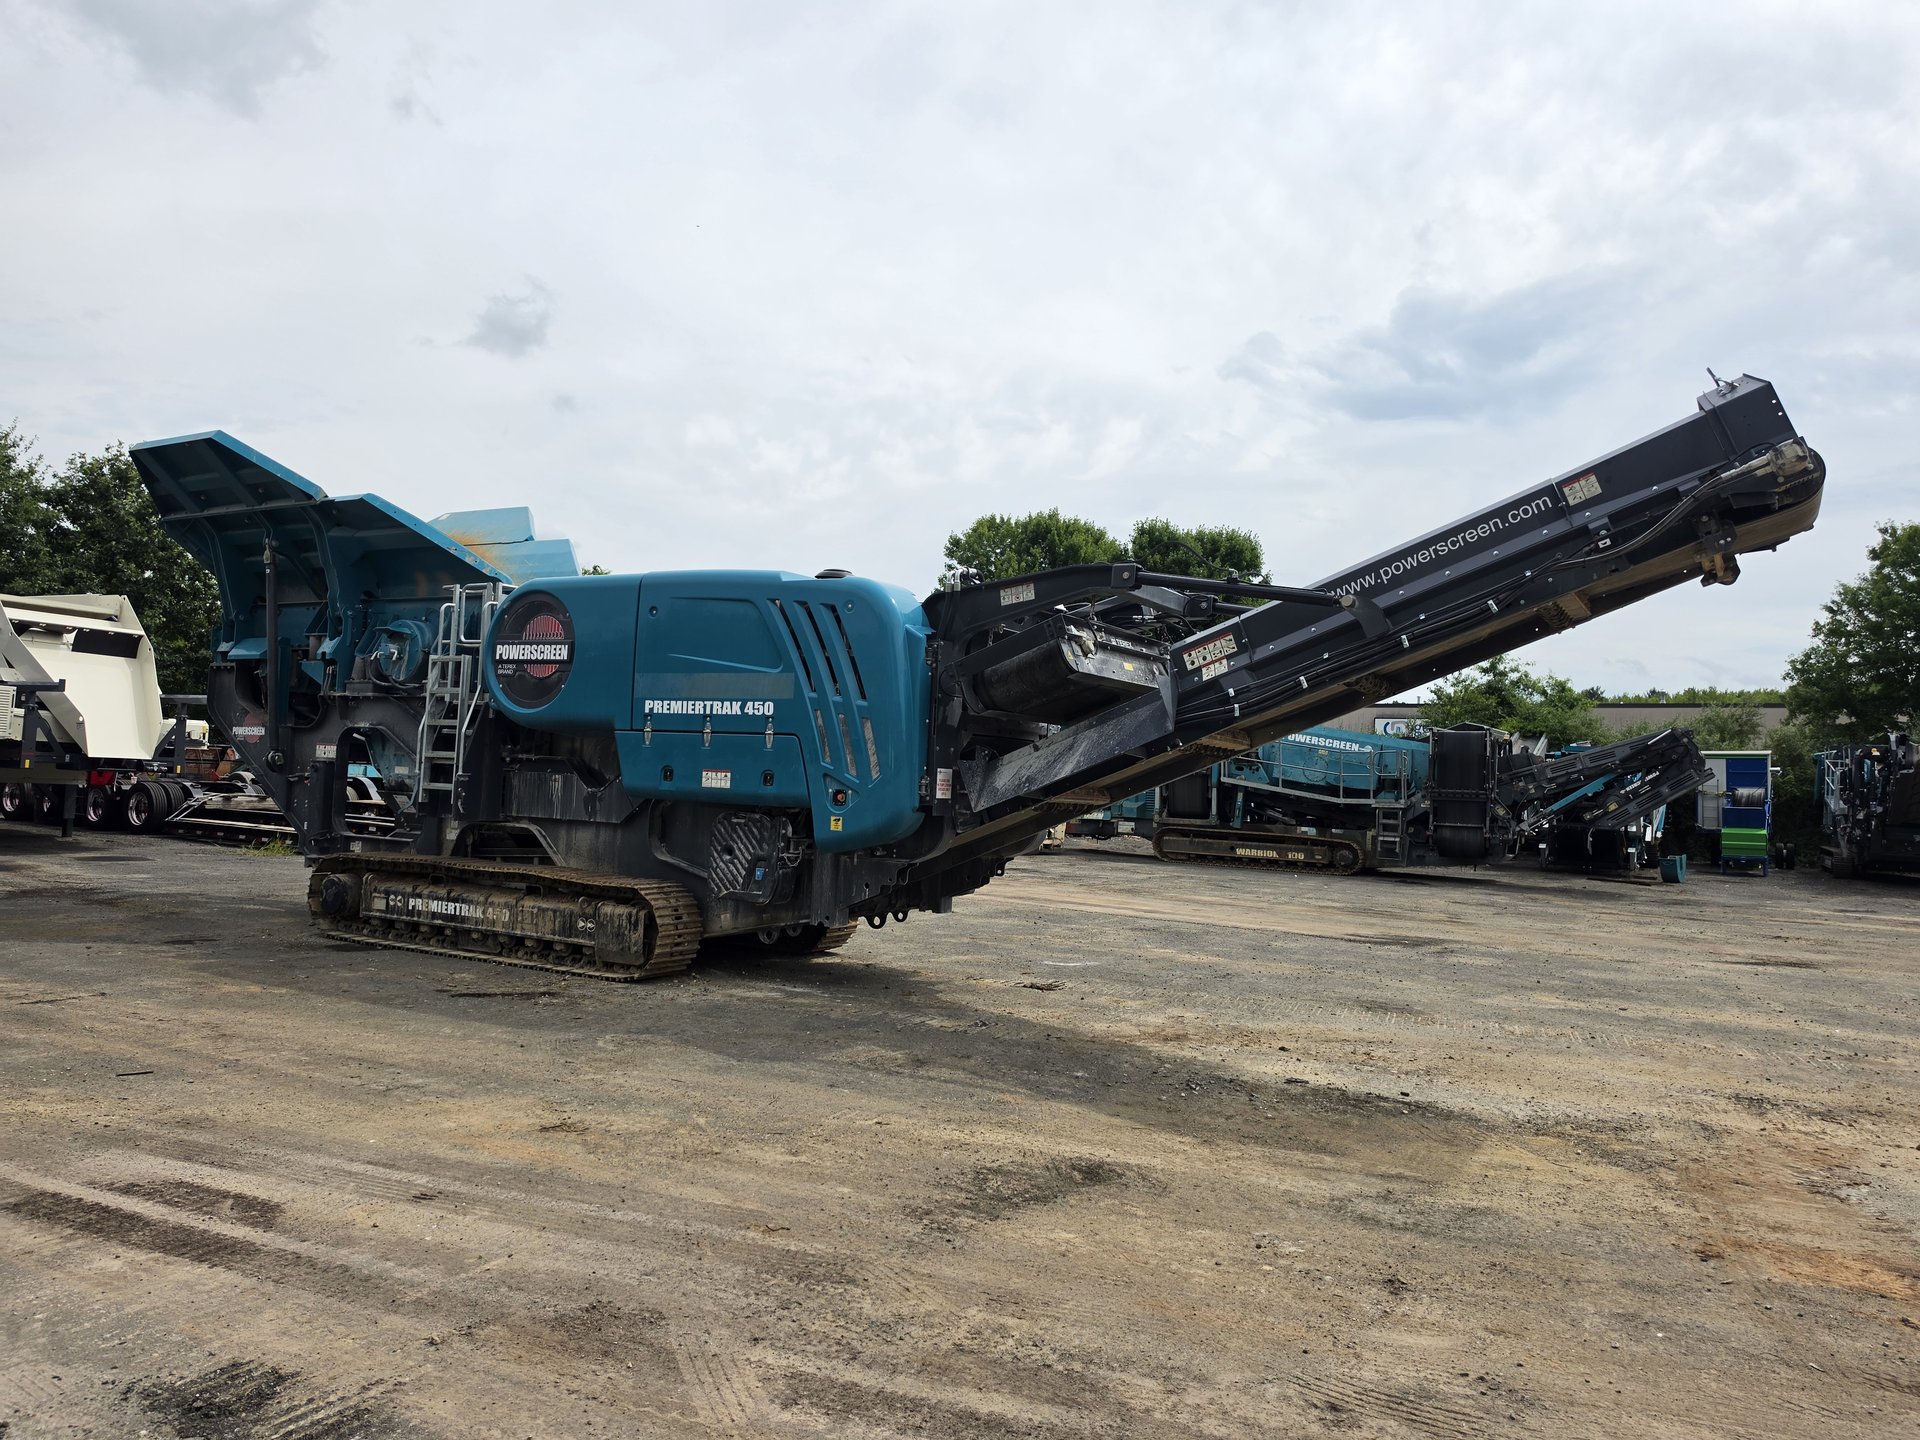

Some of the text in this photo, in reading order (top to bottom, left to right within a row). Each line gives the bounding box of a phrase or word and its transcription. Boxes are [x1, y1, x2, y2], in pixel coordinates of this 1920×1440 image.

[496, 644, 568, 660] POWERSCREEN
[644, 700, 774, 715] PREMIERTRAK 450
[232, 726, 265, 736] POWERSCREEN
[1282, 732, 1361, 752] OWERSCREEN
[408, 897, 484, 919] PREMIERTRAK
